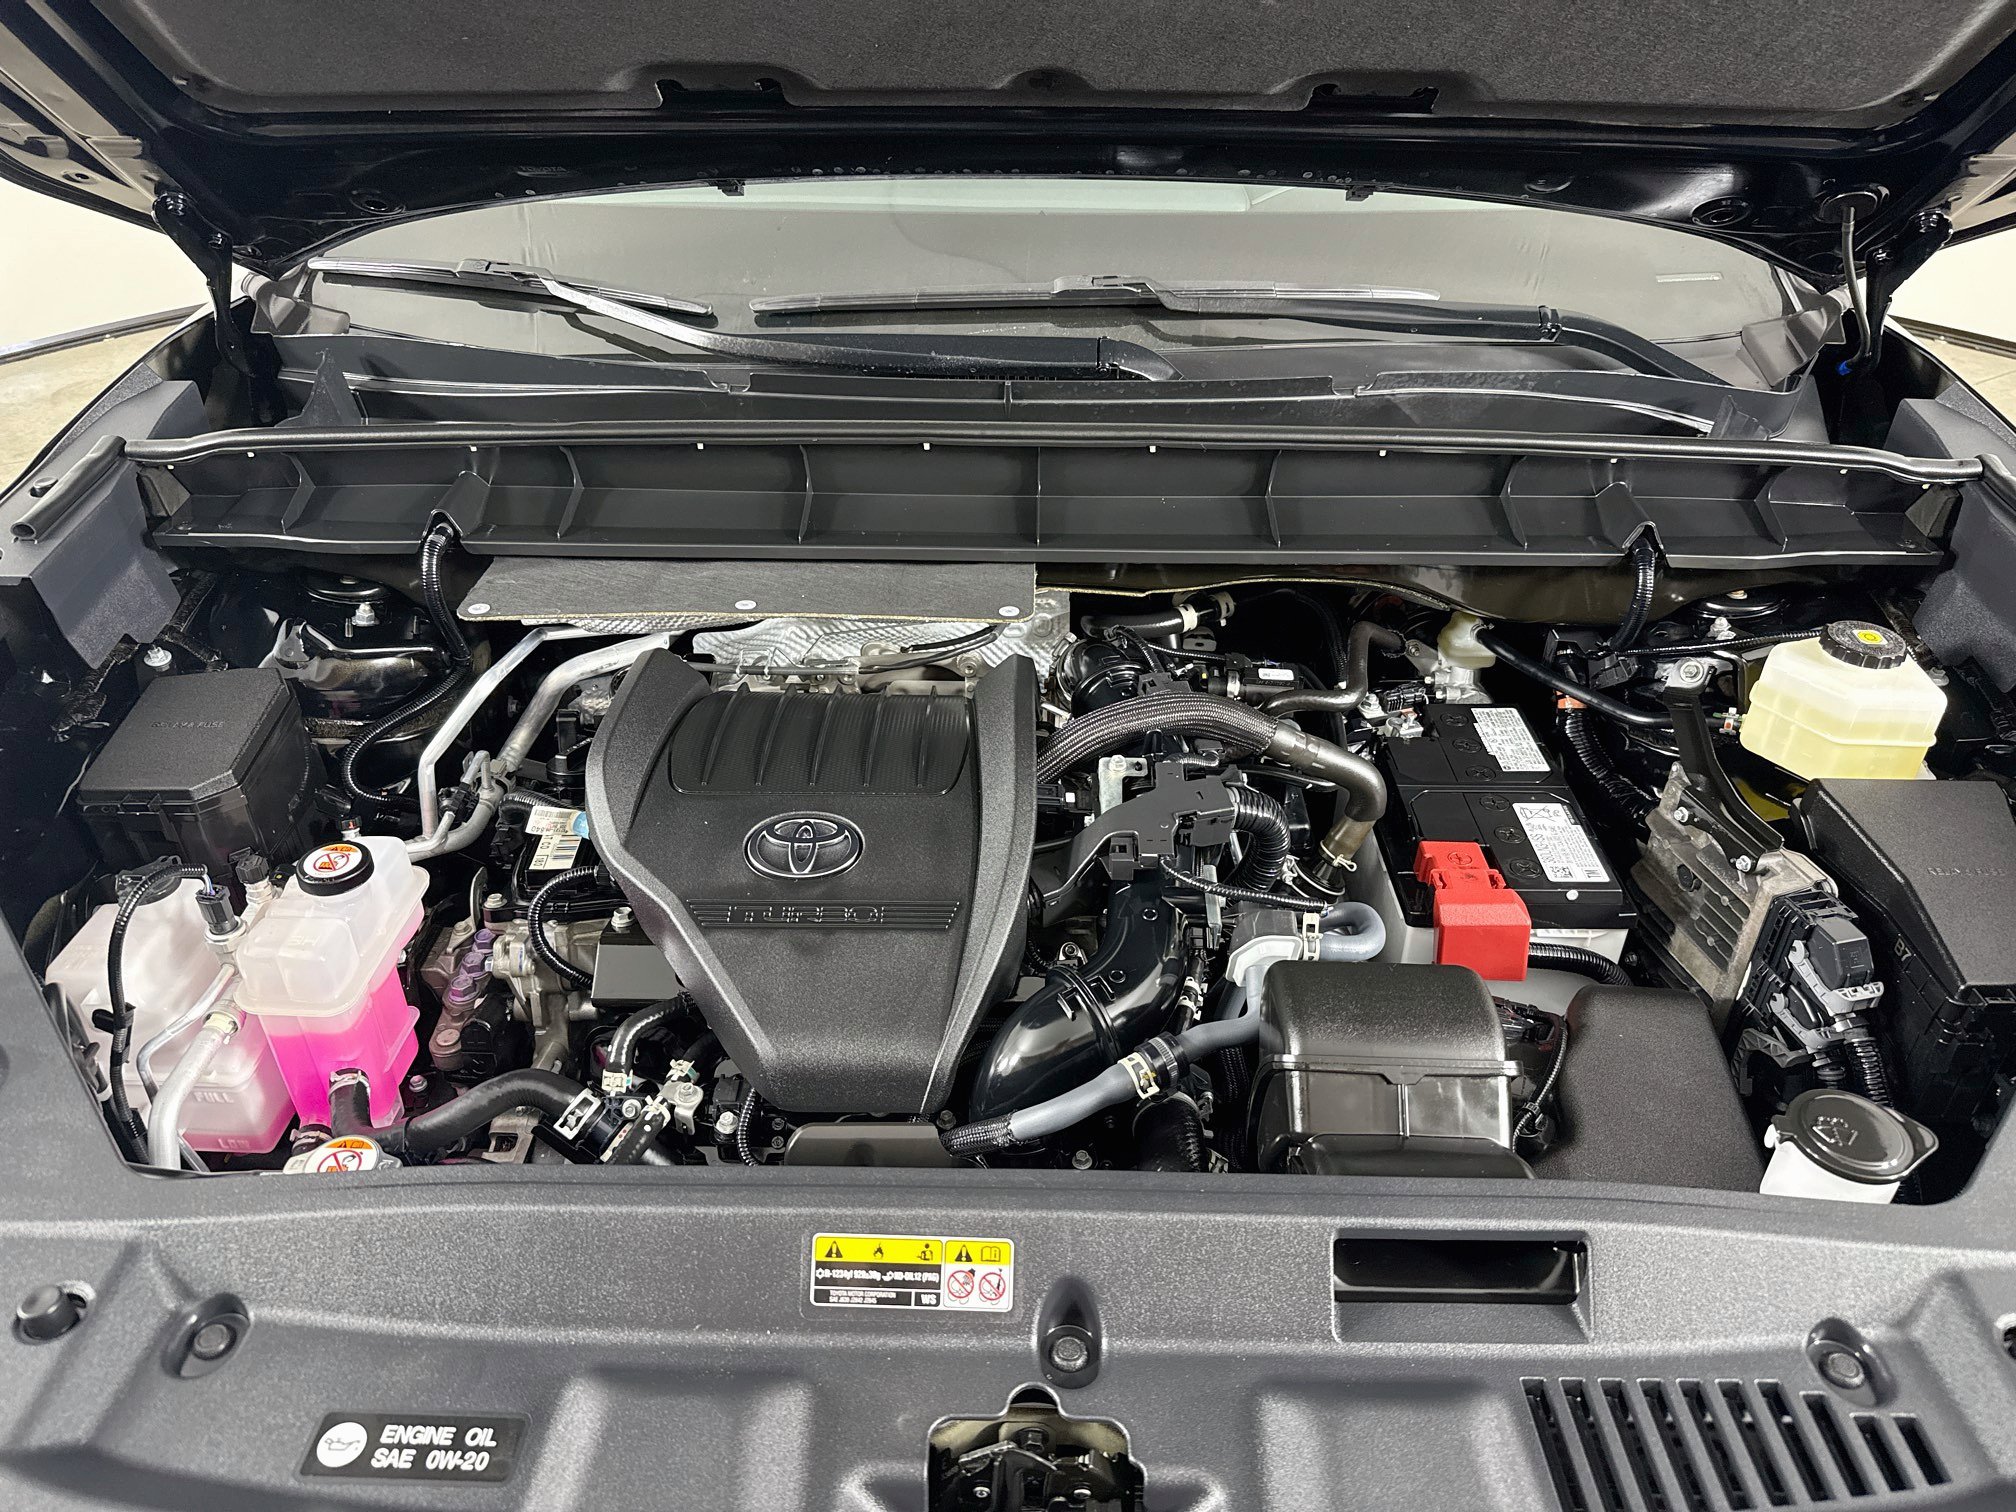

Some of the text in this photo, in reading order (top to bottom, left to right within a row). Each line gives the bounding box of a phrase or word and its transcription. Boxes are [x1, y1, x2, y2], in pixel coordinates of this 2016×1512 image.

[193, 1091, 235, 1104] FULL
[920, 1294, 937, 1304] WS
[380, 1424, 497, 1447] ENGINE OIL
[370, 1447, 490, 1471] SAE 0W-20
